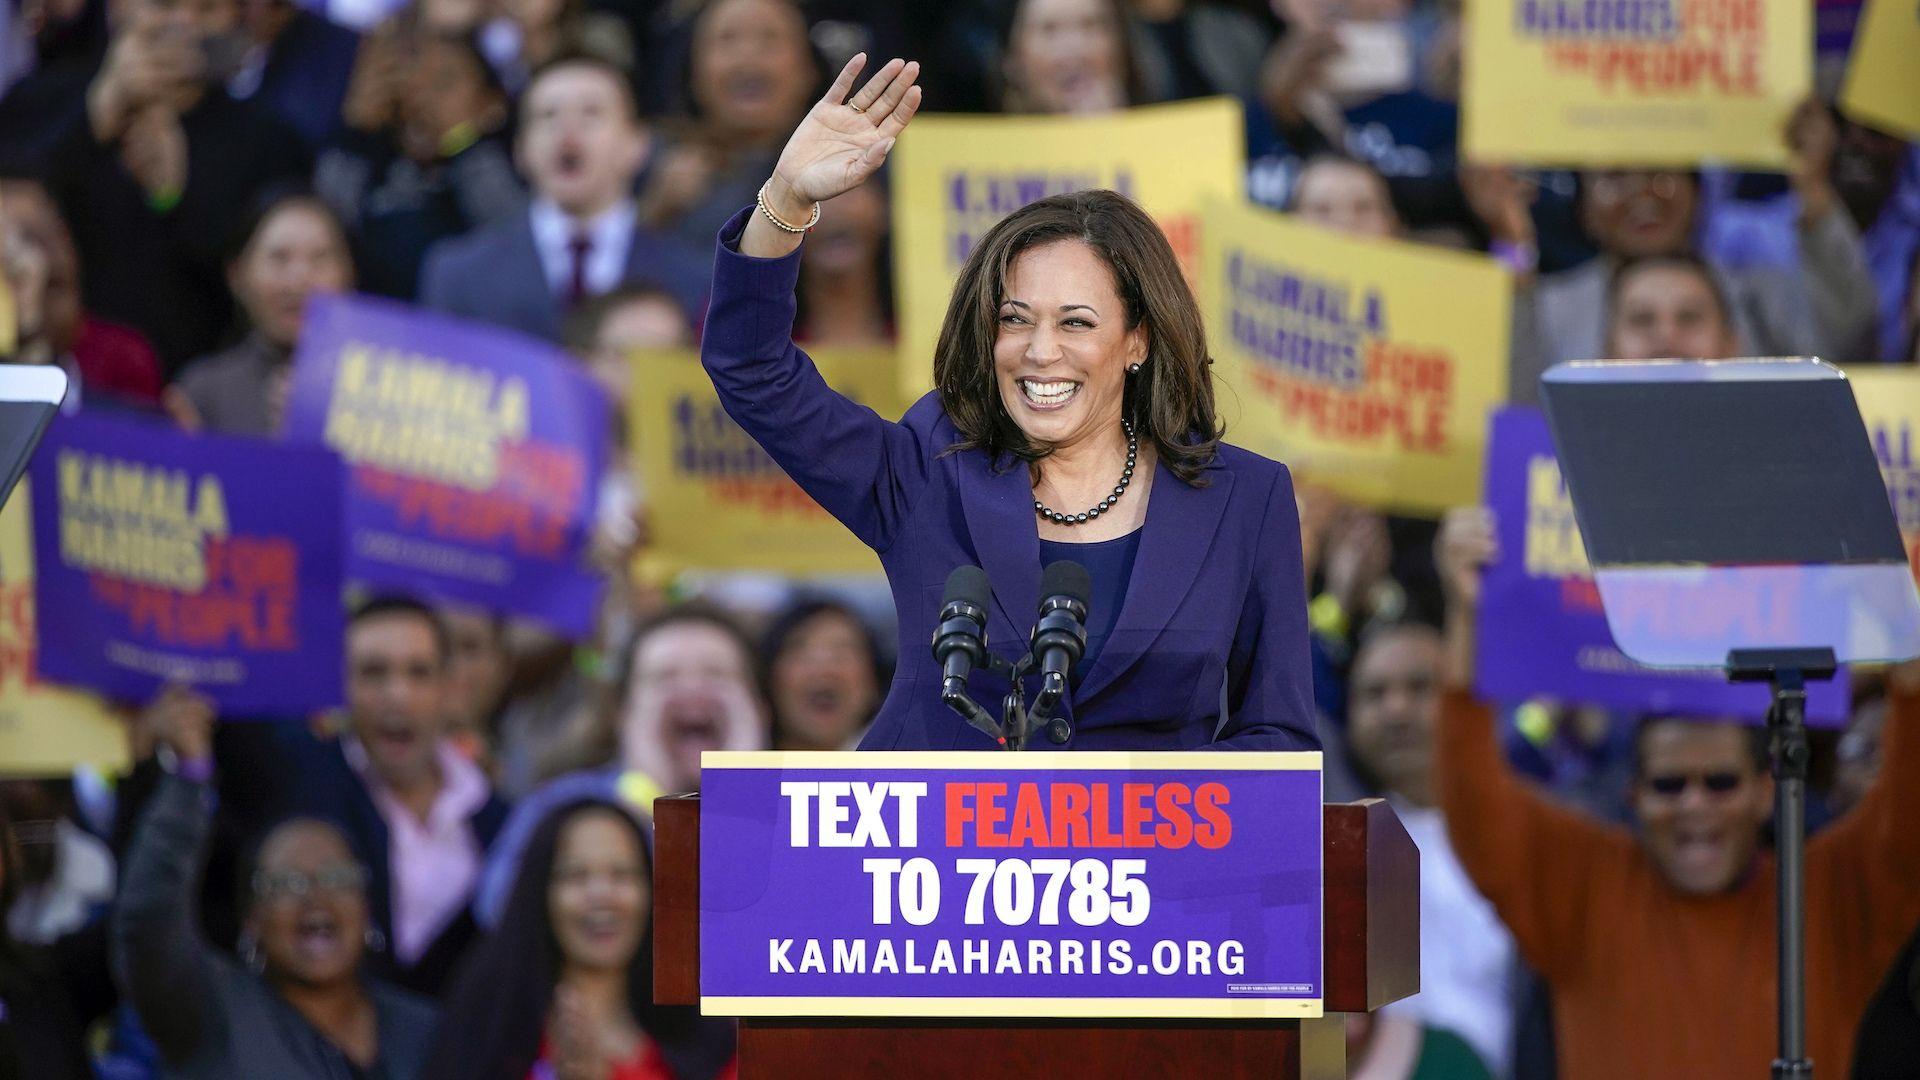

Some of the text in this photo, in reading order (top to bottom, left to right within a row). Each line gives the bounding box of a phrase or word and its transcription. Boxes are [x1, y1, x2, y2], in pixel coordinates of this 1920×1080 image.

[1226, 247, 1388, 338] KAMALA
[1365, 339, 1455, 394] FOR
[1281, 387, 1452, 455] PEOPLE
[58, 449, 230, 541] KAMALA
[781, 782, 1232, 850] TEXT FEARLESS
[863, 857, 1151, 926] TO 70785
[768, 938, 1246, 976] KAMALAHARRIS.ORG
